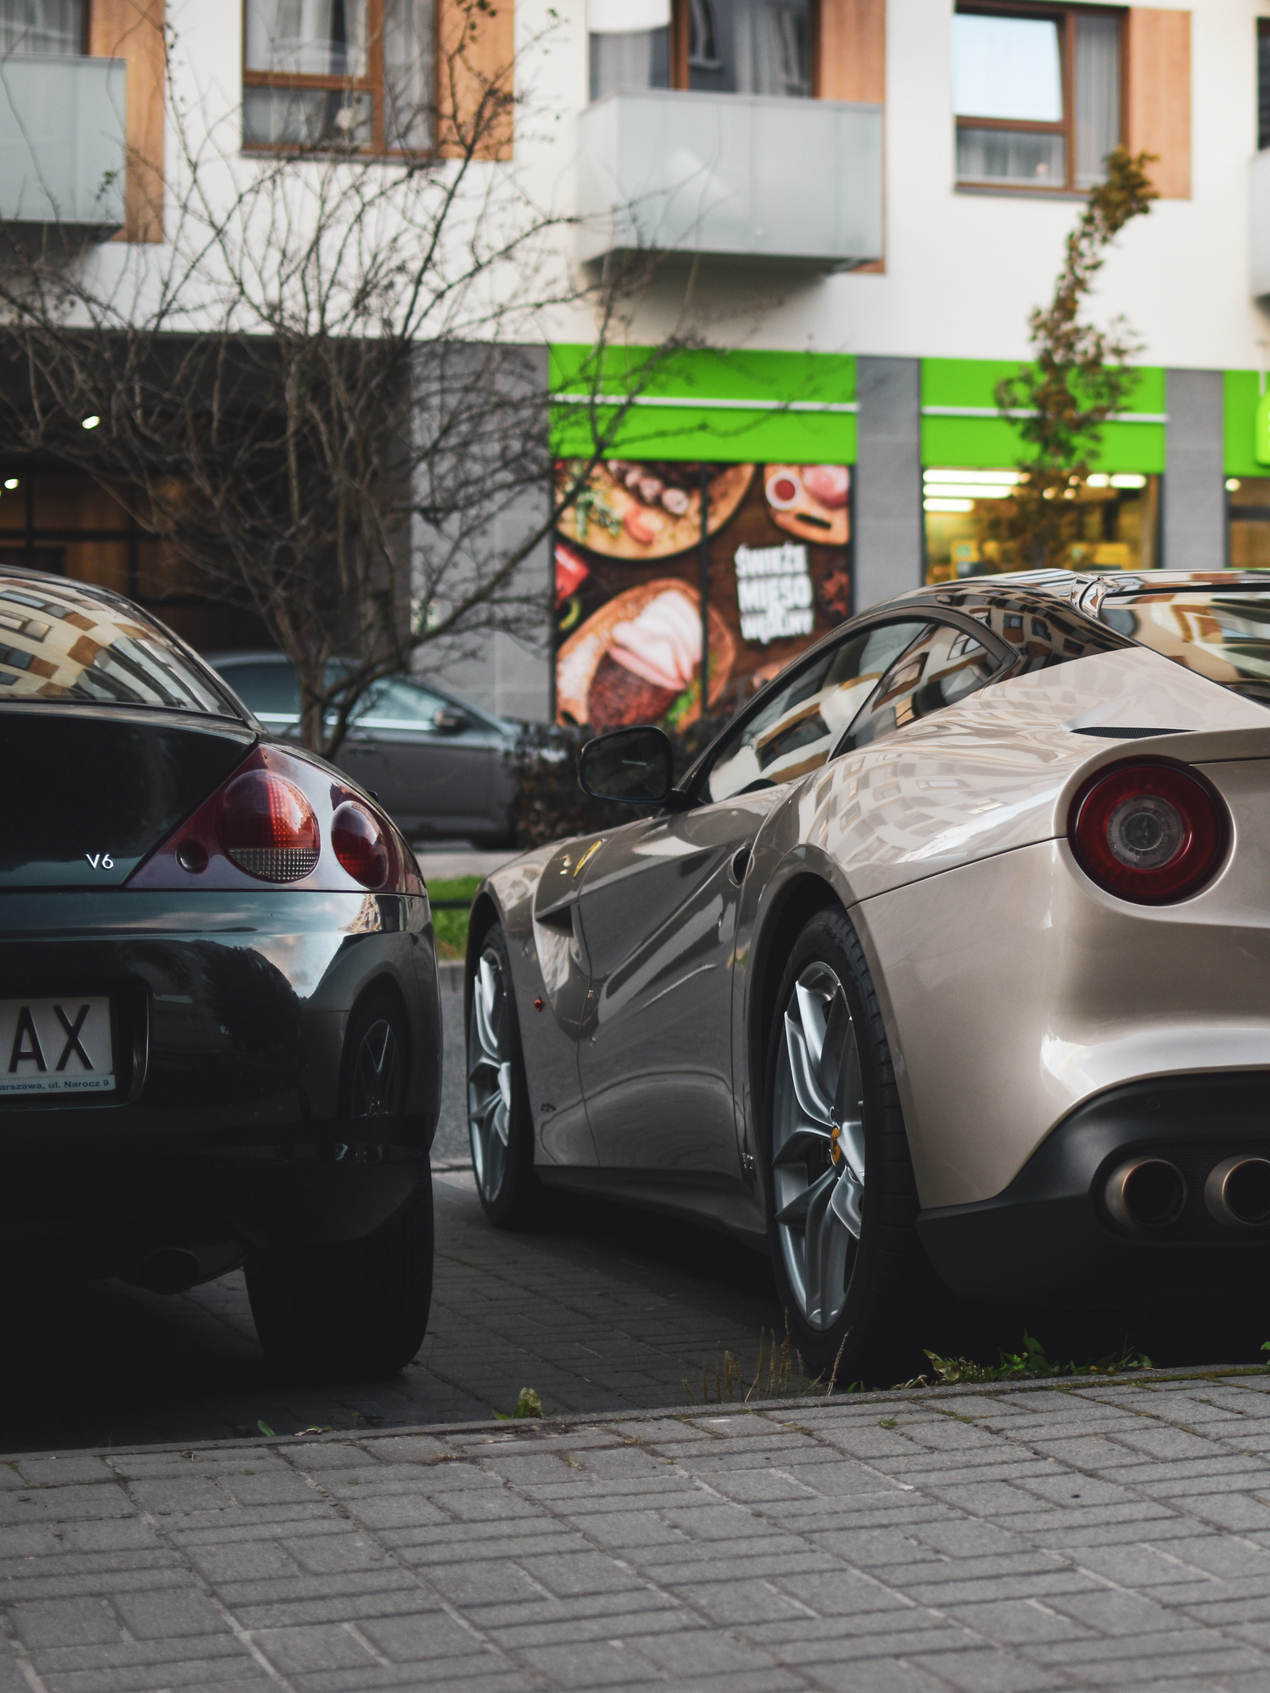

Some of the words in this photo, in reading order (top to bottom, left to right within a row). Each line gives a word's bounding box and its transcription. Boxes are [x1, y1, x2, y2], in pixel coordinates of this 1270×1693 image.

[85, 853, 114, 869] V6
[8, 1004, 94, 1073] AX
[48, 1081, 60, 1089] ul.
[64, 1080, 100, 1088] Narocz
[103, 1079, 110, 1087] 9
